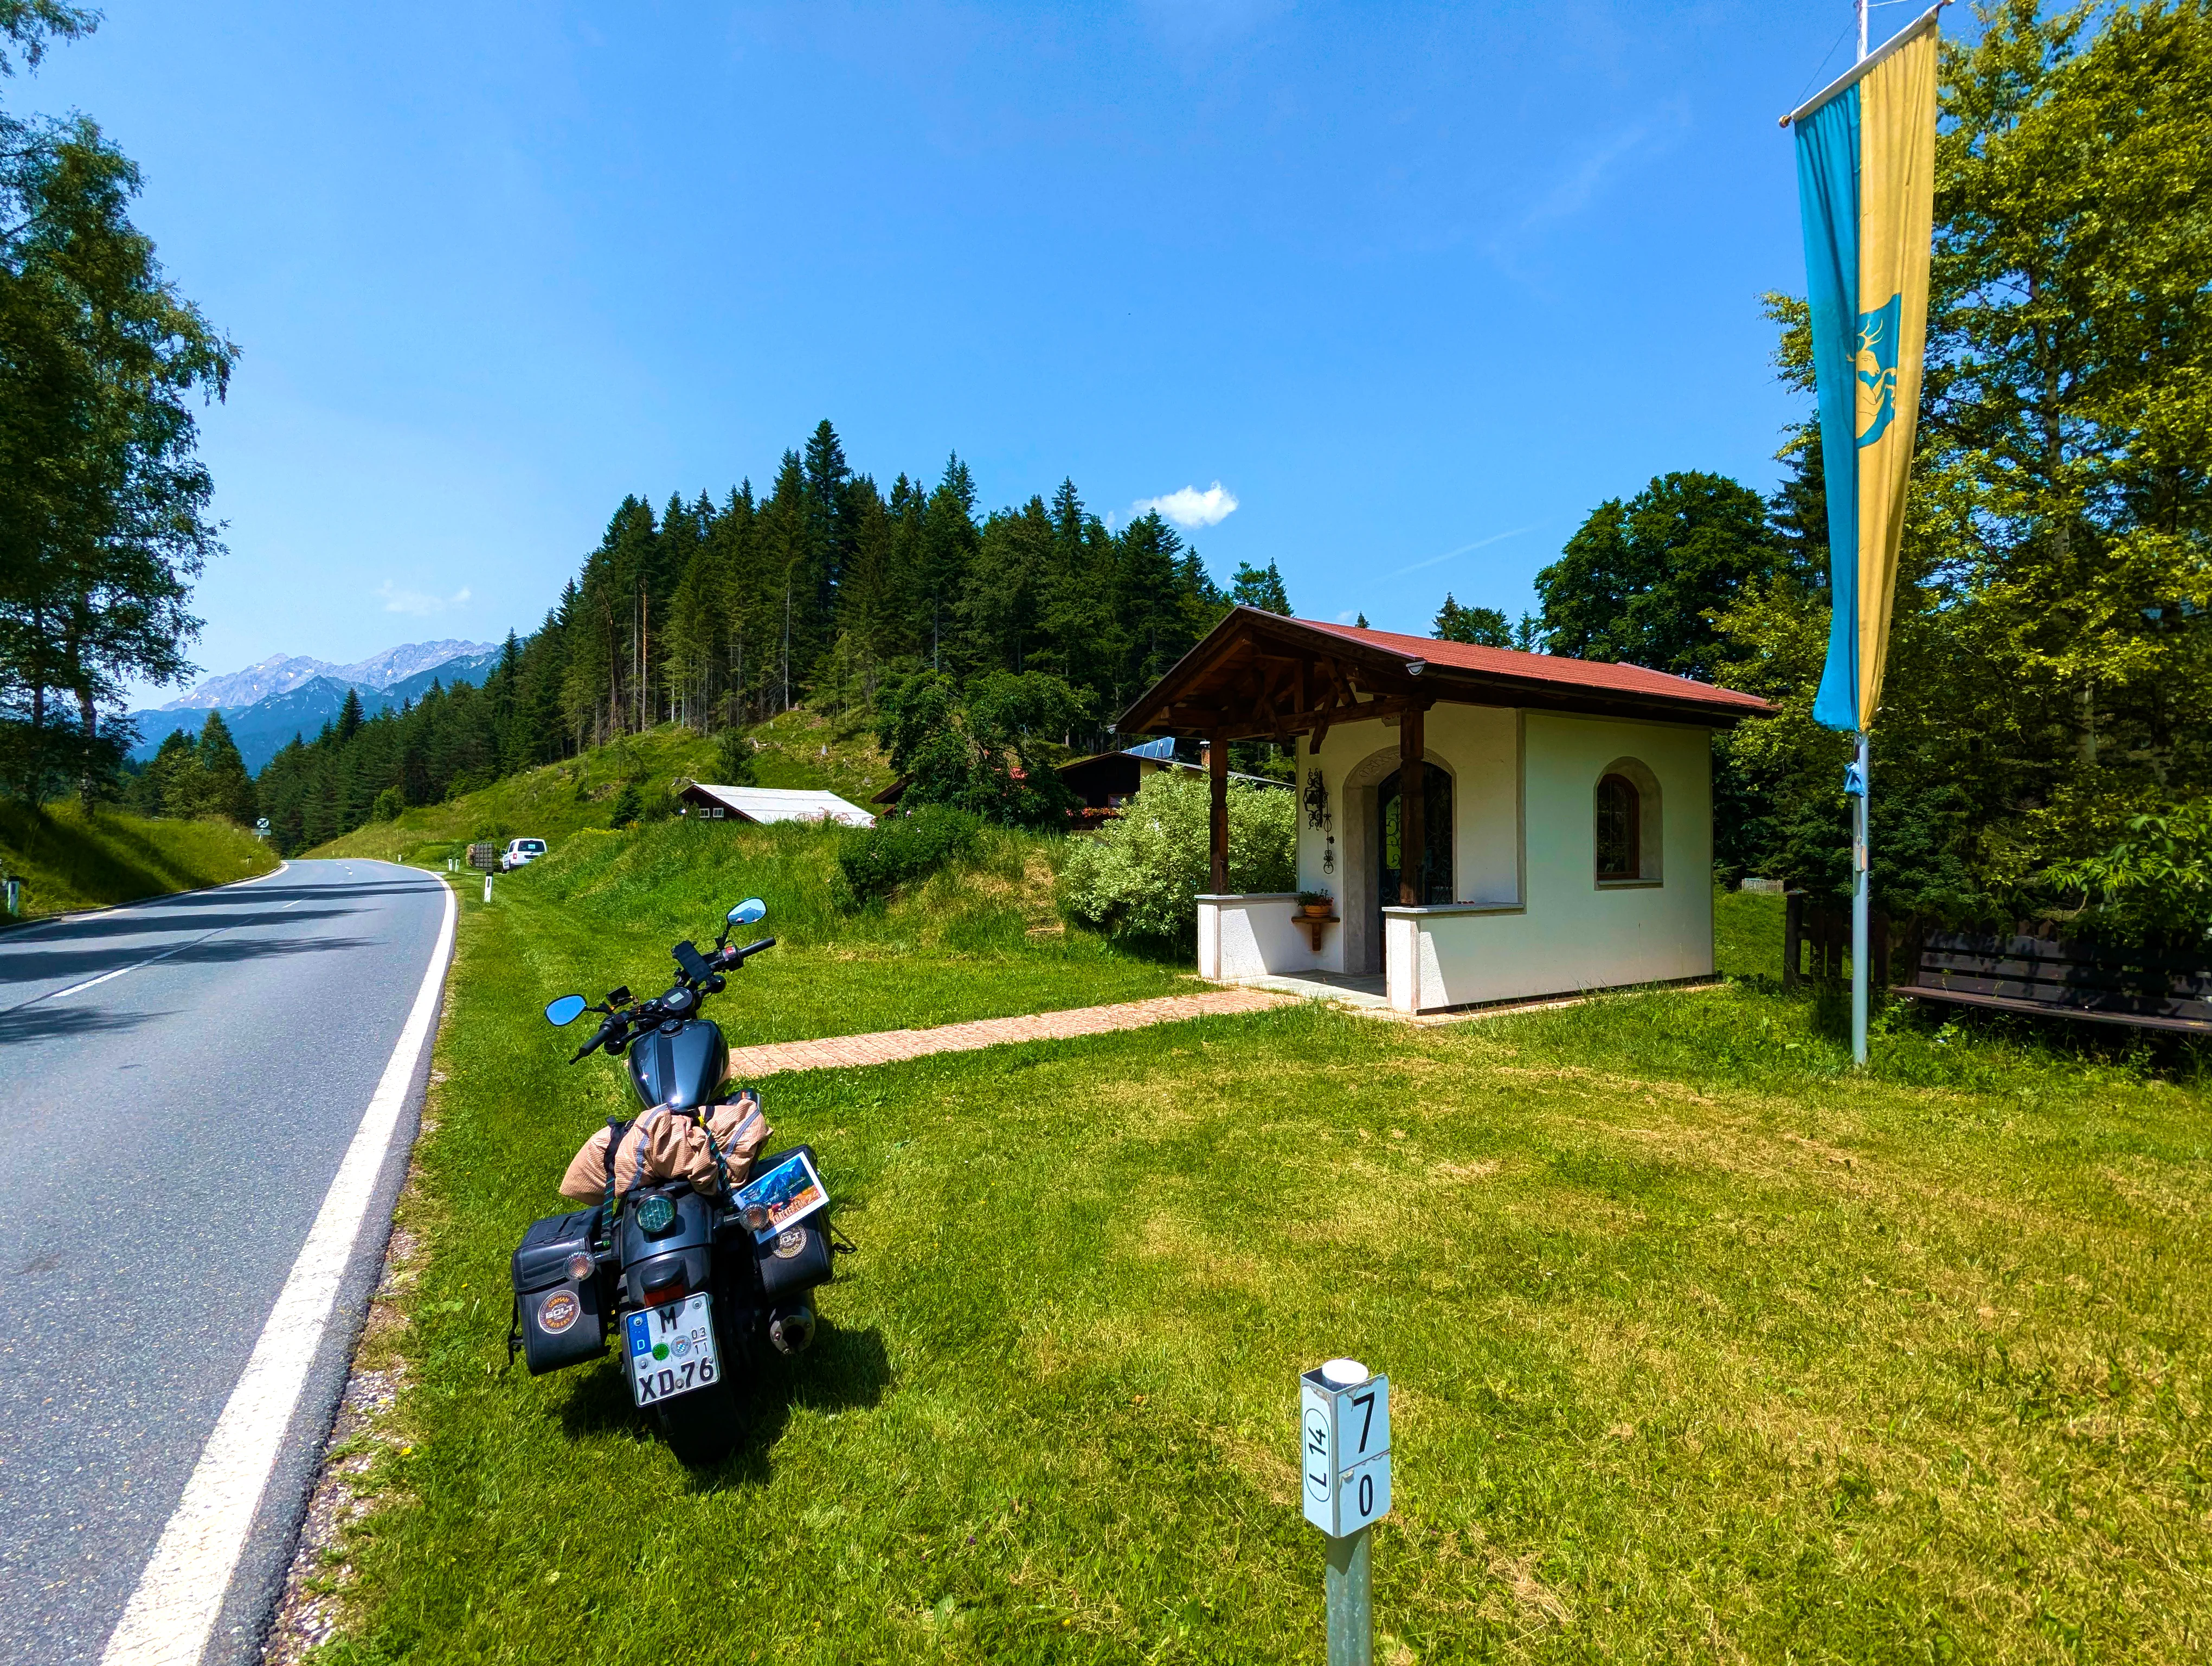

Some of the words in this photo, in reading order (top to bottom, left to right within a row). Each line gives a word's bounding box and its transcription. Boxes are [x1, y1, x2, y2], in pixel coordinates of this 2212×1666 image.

[548, 1296, 569, 1308] GERMAN
[545, 1304, 574, 1319] BOLT
[659, 1306, 677, 1333] M
[691, 1327, 706, 1339] 03
[636, 1339, 645, 1350] D
[694, 1342, 708, 1355] 11
[638, 1368, 674, 1402] XD
[680, 1356, 714, 1388] 76
[1353, 1392, 1375, 1454] 7
[1308, 1426, 1327, 1456] 14
[1309, 1473, 1327, 1488] L
[1359, 1474, 1373, 1517] 0
